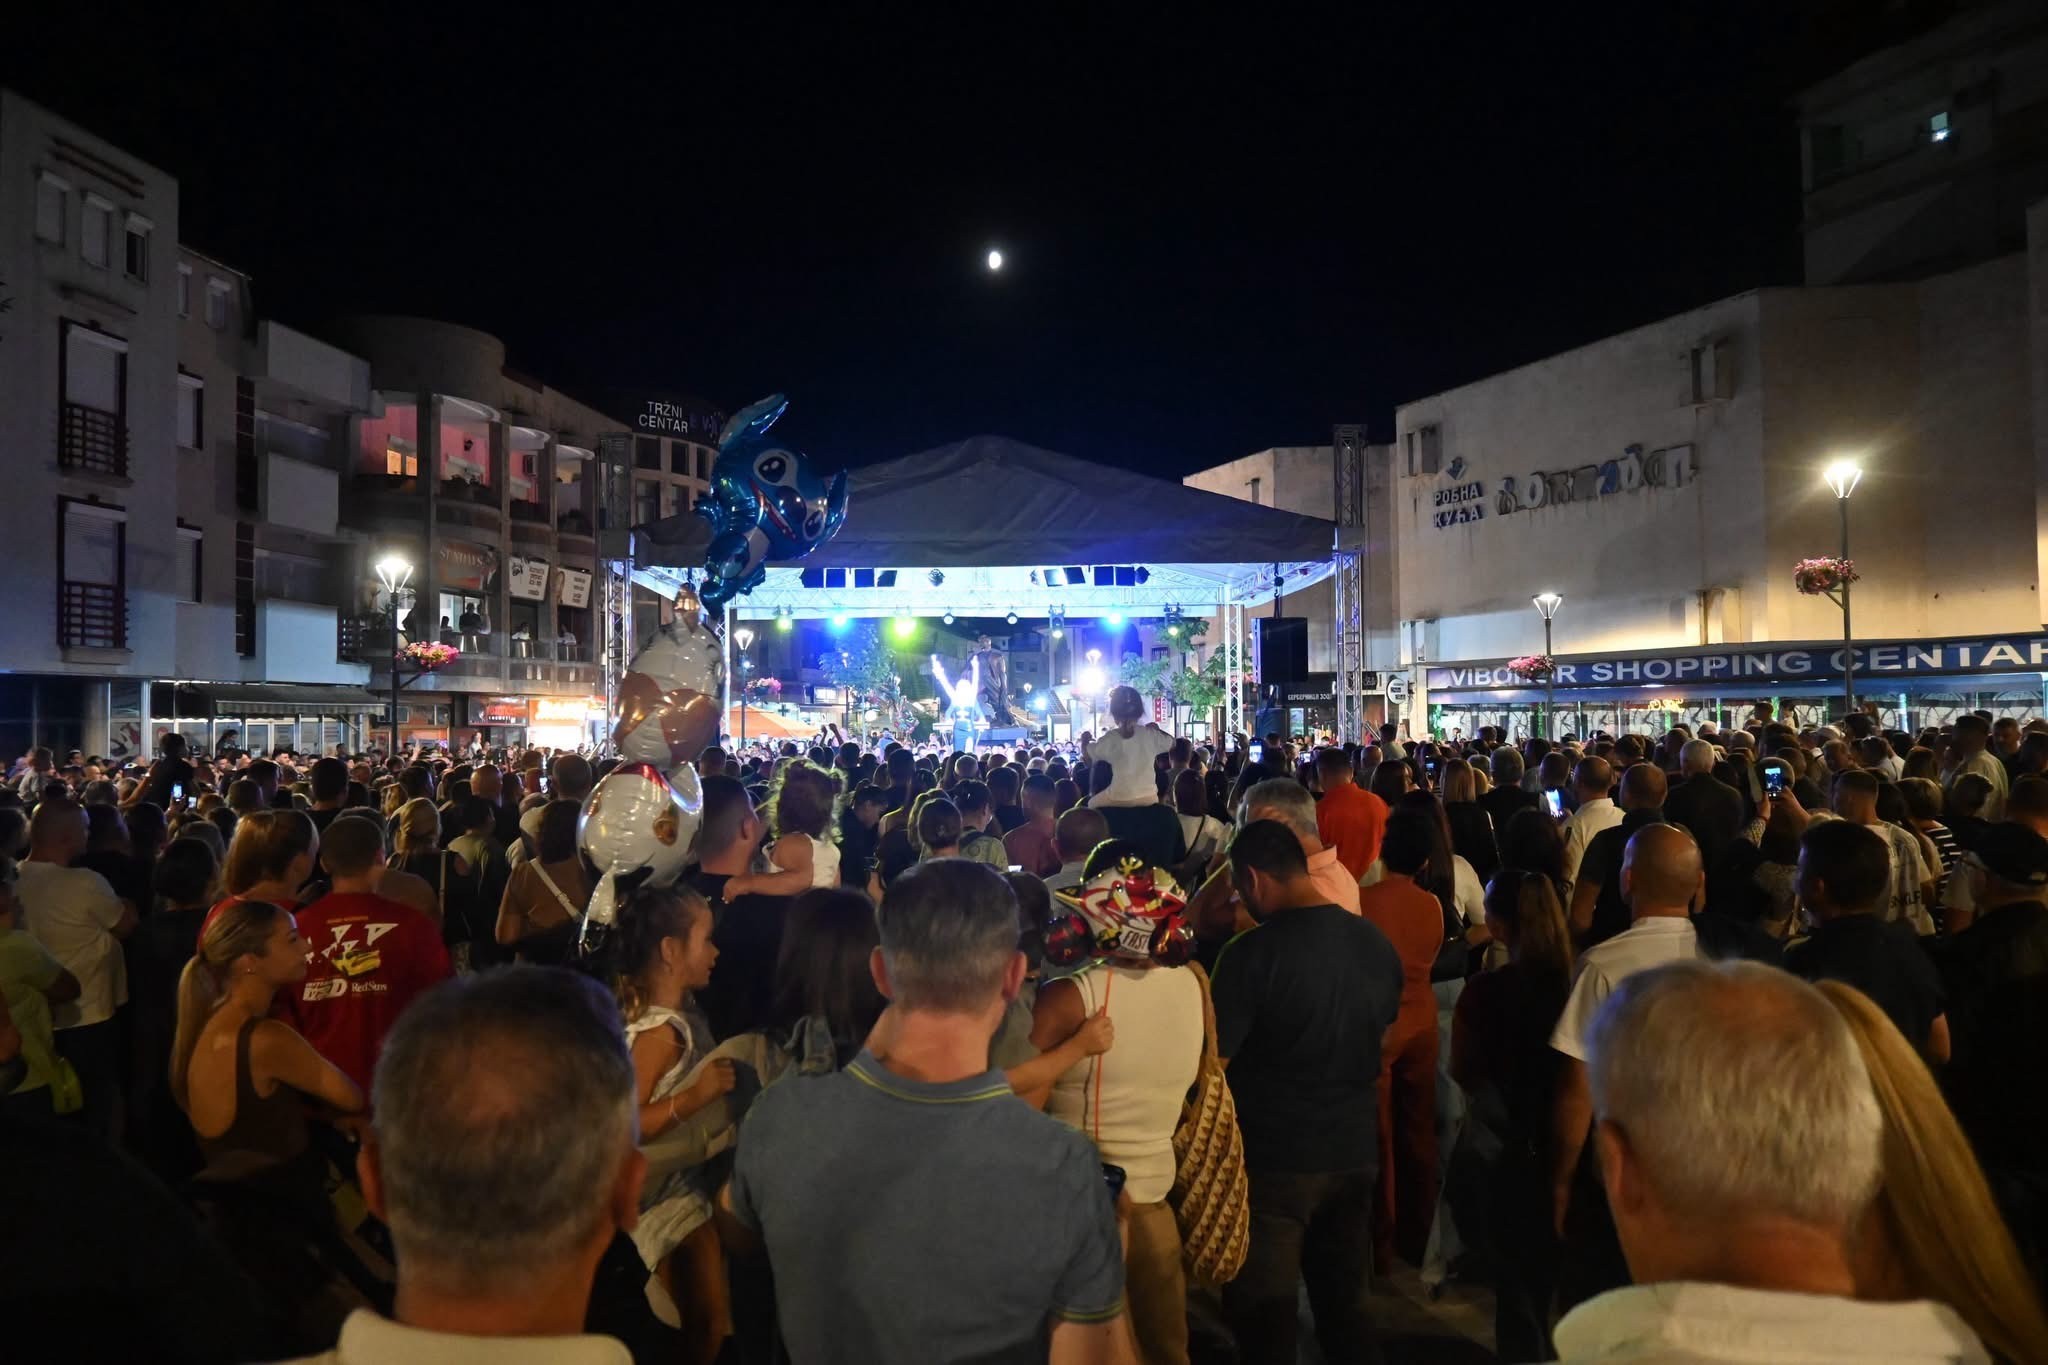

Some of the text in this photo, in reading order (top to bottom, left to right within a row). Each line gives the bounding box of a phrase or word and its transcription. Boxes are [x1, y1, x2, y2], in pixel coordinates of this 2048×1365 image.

[648, 401, 683, 419] TRŽNI
[638, 414, 689, 433] CENTAR
[1434, 484, 1482, 506] РОБНА
[1434, 503, 1482, 526] КУЋА
[1591, 651, 1812, 682] SHOPPING
